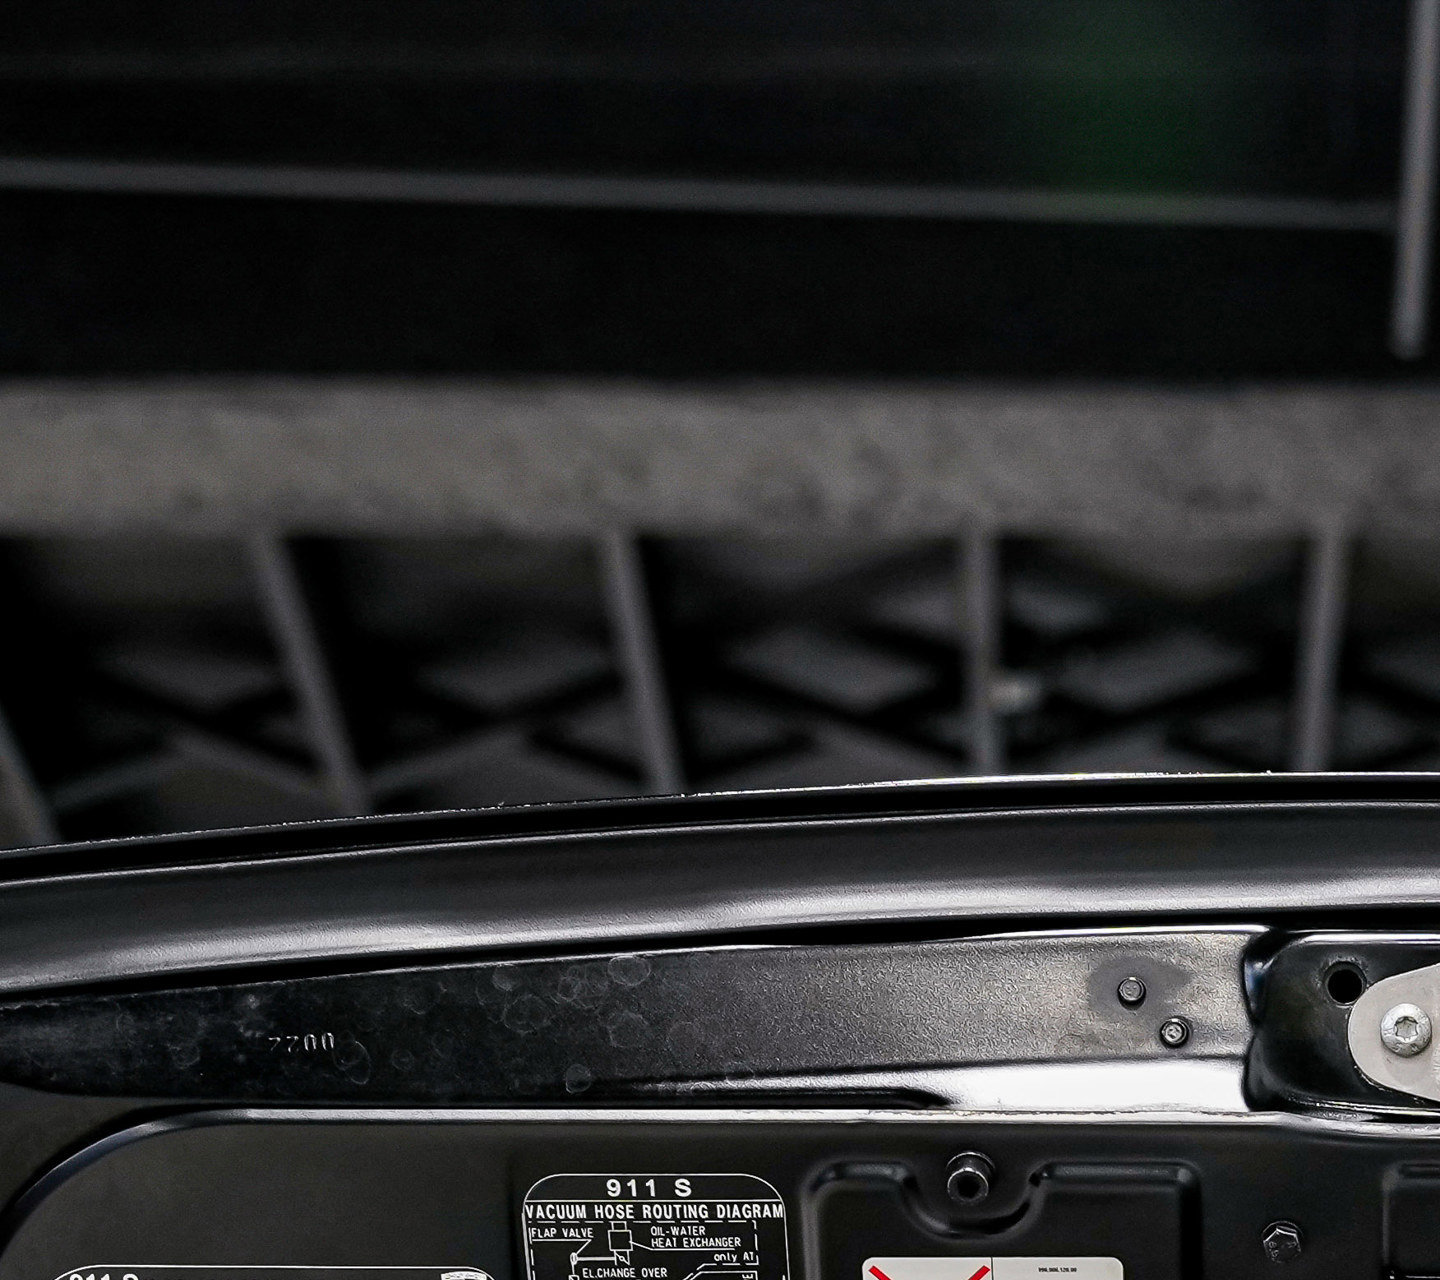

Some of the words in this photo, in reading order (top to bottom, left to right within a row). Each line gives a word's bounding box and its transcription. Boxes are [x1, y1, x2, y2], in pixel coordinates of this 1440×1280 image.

[607, 1179, 655, 1197] 911
[675, 1179, 691, 1197] S
[525, 1205, 586, 1219] VACUUM
[595, 1204, 634, 1219] HOSE
[643, 1204, 708, 1219] ROUTING
[717, 1204, 783, 1218] DIAGRAM
[532, 1228, 556, 1238] FLAP
[562, 1228, 593, 1238] VALVE
[651, 1226, 705, 1236] OIL-WATER
[652, 1238, 676, 1247] HEAT
[683, 1237, 741, 1247] EXCHANGER
[714, 1253, 737, 1262] only
[744, 1252, 755, 1261] AT
[642, 1268, 667, 1277] OVER
